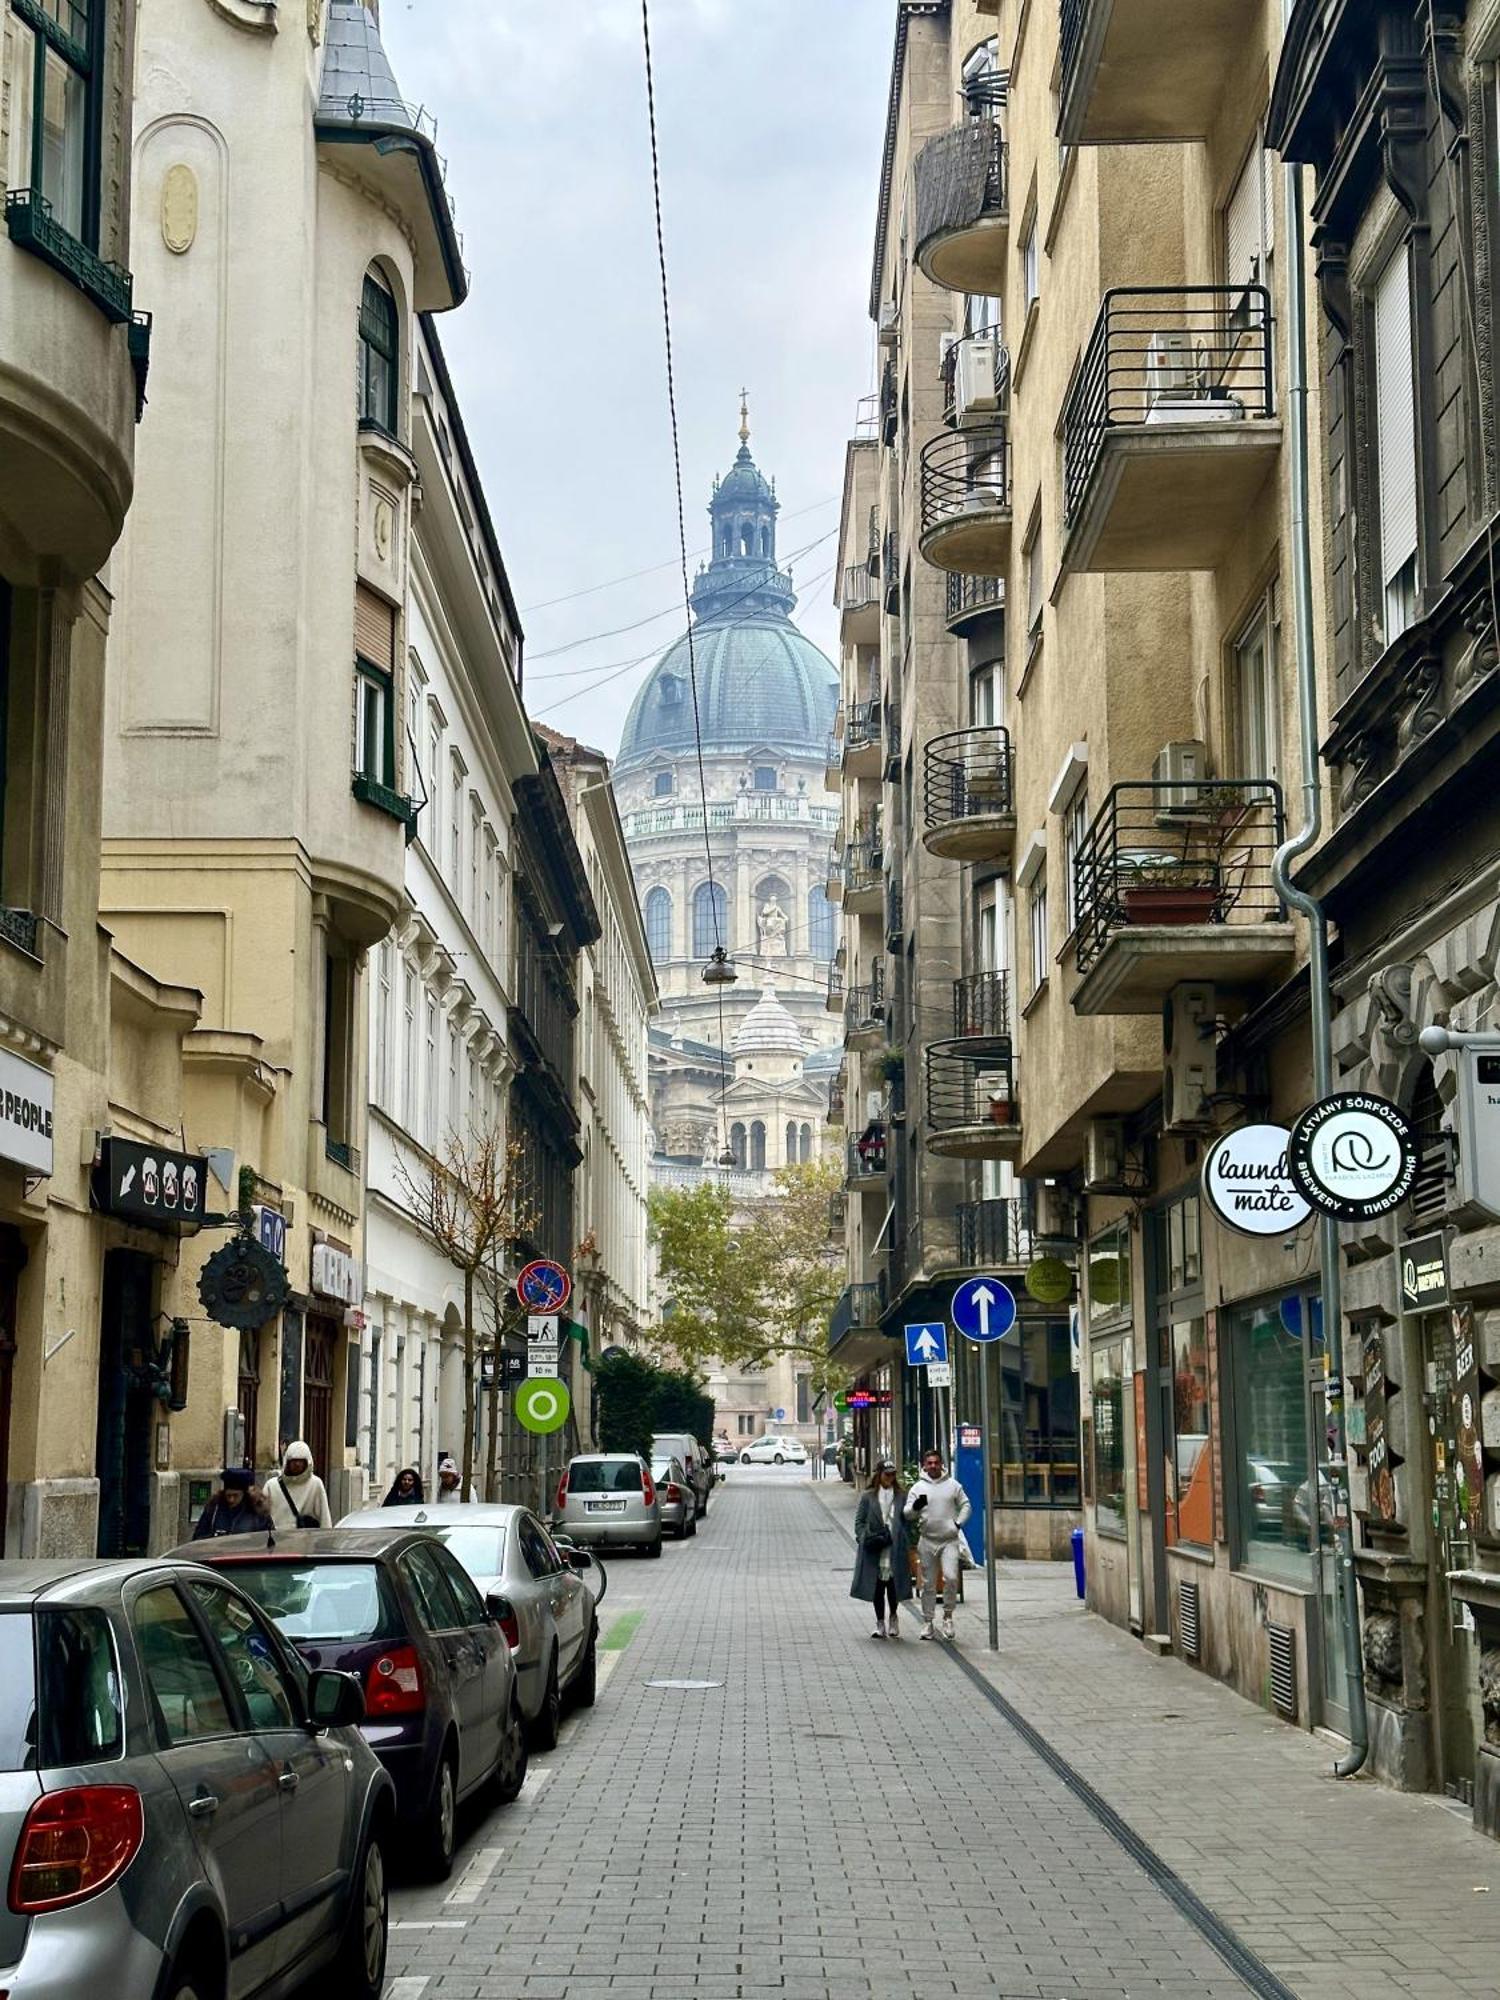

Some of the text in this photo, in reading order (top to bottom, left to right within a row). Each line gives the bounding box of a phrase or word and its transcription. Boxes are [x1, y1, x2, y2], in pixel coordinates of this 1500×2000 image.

[1300, 1097, 1409, 1142] LÁTVÁNY SÖRFŐZDE
[1218, 1149, 1291, 1180] laund
[1234, 1183, 1295, 1212] mate
[1298, 1161, 1342, 1211] BREWERY
[1363, 1155, 1417, 1215] ПИВОВАРНЯ
[1456, 1343, 1474, 1382] BEER
[1368, 1436, 1385, 1475] FOOD
